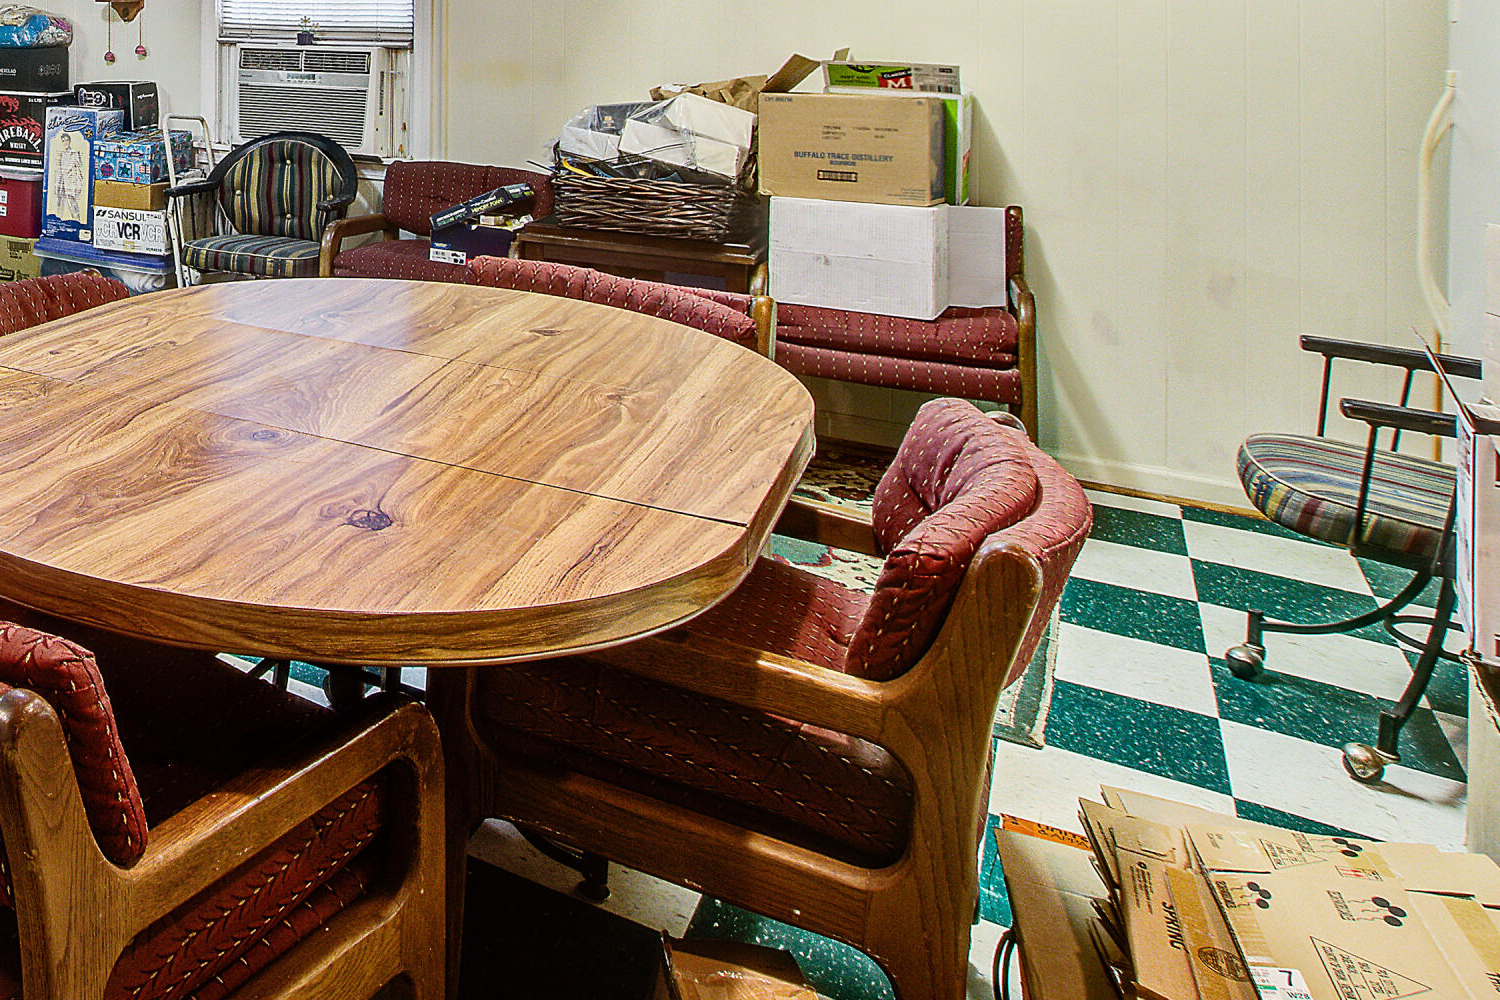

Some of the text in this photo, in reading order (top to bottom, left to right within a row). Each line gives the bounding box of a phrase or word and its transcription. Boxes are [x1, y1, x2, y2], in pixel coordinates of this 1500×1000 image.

[9, 142, 27, 150] WHISKY
[794, 151, 894, 162] BUFFALO TRACE DISTILLERY
[95, 219, 119, 238] VCR
[117, 221, 141, 240] VCR
[140, 224, 166, 243] VCR
[1162, 901, 1190, 955] SPRING
[1279, 970, 1293, 987] 7
